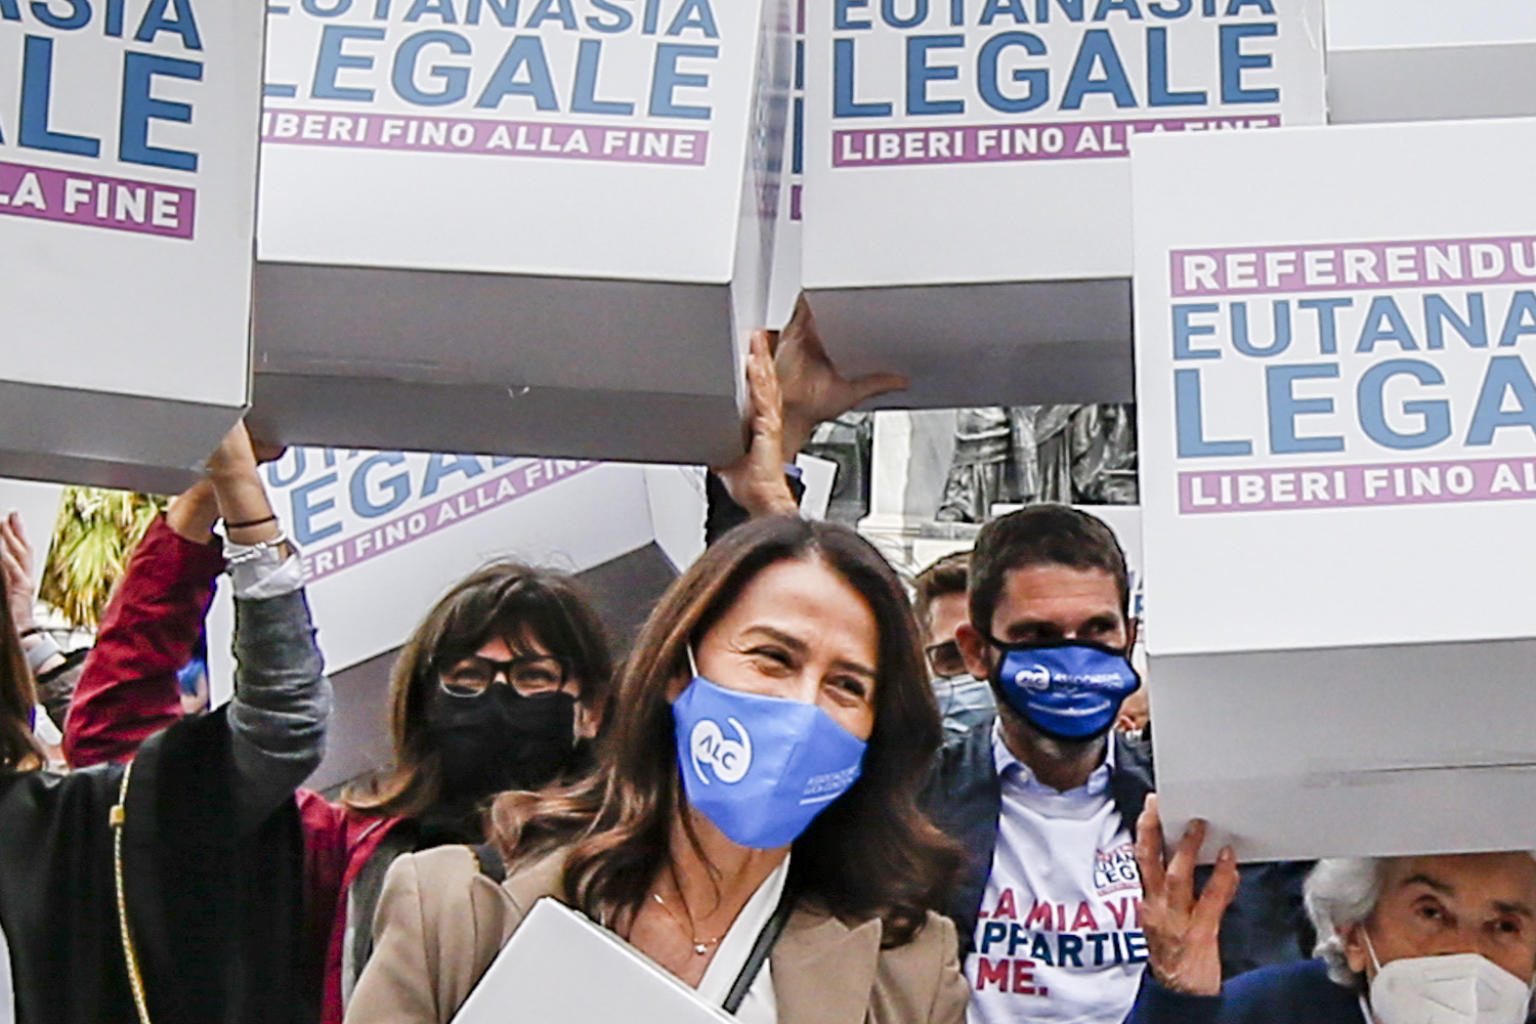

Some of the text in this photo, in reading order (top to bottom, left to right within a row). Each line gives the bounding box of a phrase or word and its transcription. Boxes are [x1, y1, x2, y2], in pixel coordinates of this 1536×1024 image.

[832, 23, 1281, 118] LEGALE
[0, 34, 204, 173] LE
[380, 119, 476, 147] FINO
[486, 125, 590, 154] ALLA
[603, 131, 696, 158] FINE
[842, 132, 964, 161] LIBERI
[978, 127, 1065, 157] FINO
[1075, 123, 1170, 152] AL
[64, 178, 180, 228] FINE
[1190, 470, 1346, 506] LIBERI
[1363, 463, 1475, 498] FINO
[356, 514, 426, 559] FINO
[436, 480, 516, 527] ALLA
[524, 459, 592, 489] FIN
[1024, 898, 1099, 932] MIA
[975, 956, 1049, 996] ME.
